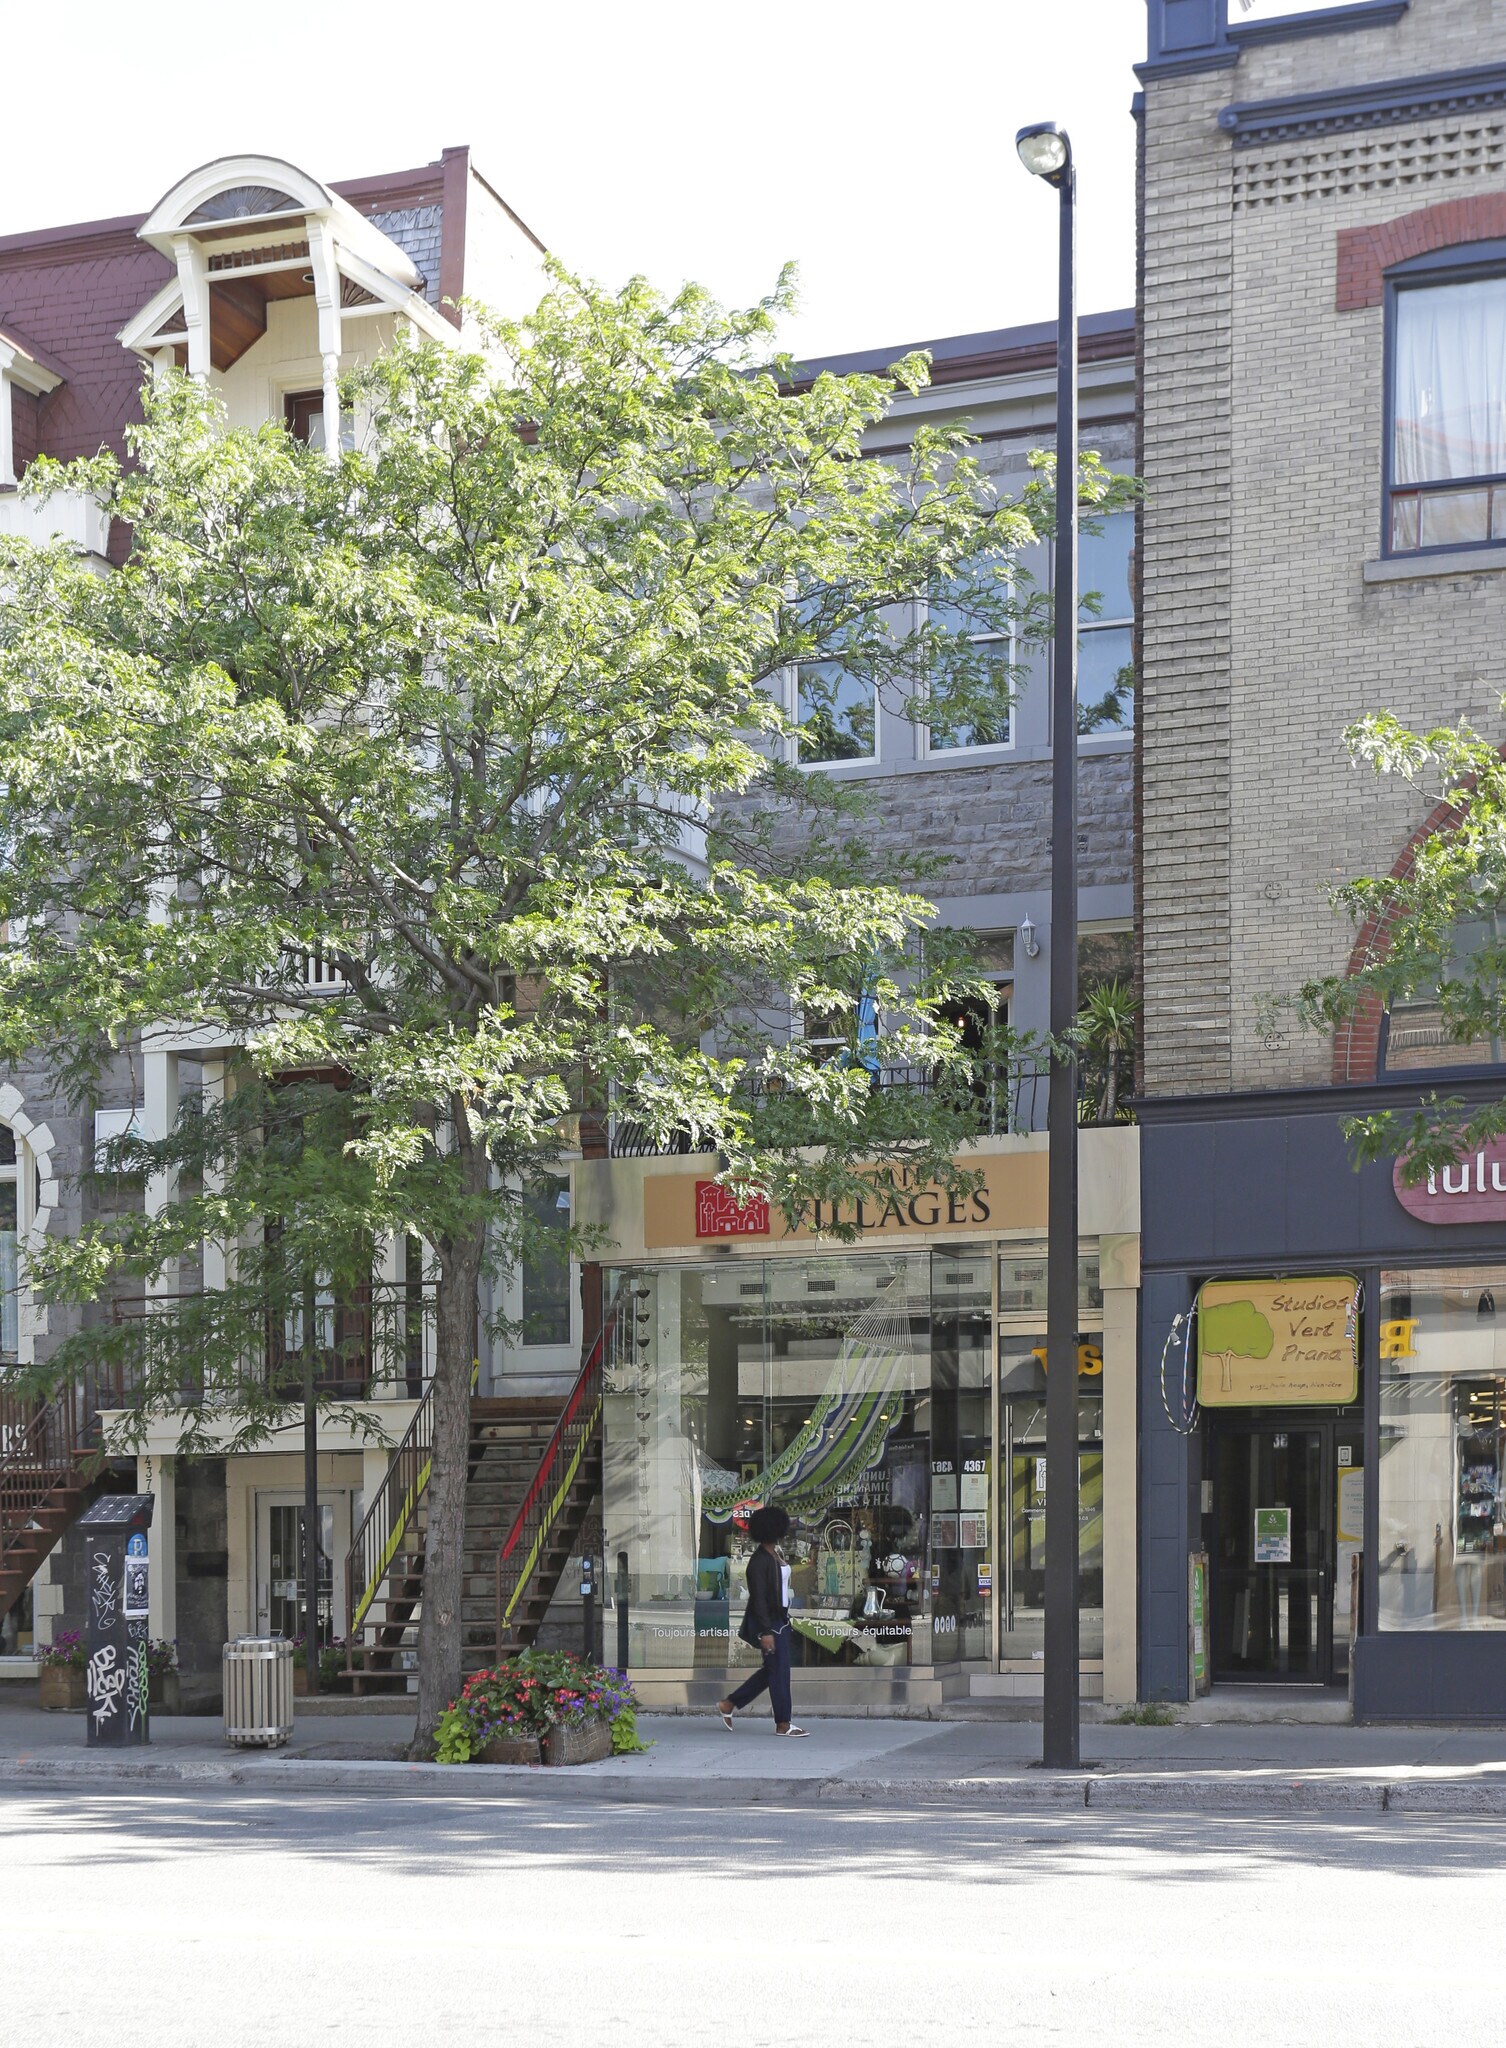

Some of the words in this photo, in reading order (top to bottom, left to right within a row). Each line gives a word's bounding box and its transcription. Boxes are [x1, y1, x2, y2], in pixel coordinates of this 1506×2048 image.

[1271, 1294, 1350, 1313] Studios
[1289, 1317, 1335, 1337] Vert
[1281, 1344, 1342, 1362] Prana
[144, 1455, 153, 1494] 437
[964, 1460, 985, 1472] 4367
[653, 1627, 696, 1638] Toujours
[814, 1626, 859, 1638] Toujours
[863, 1624, 914, 1638] équitable.
